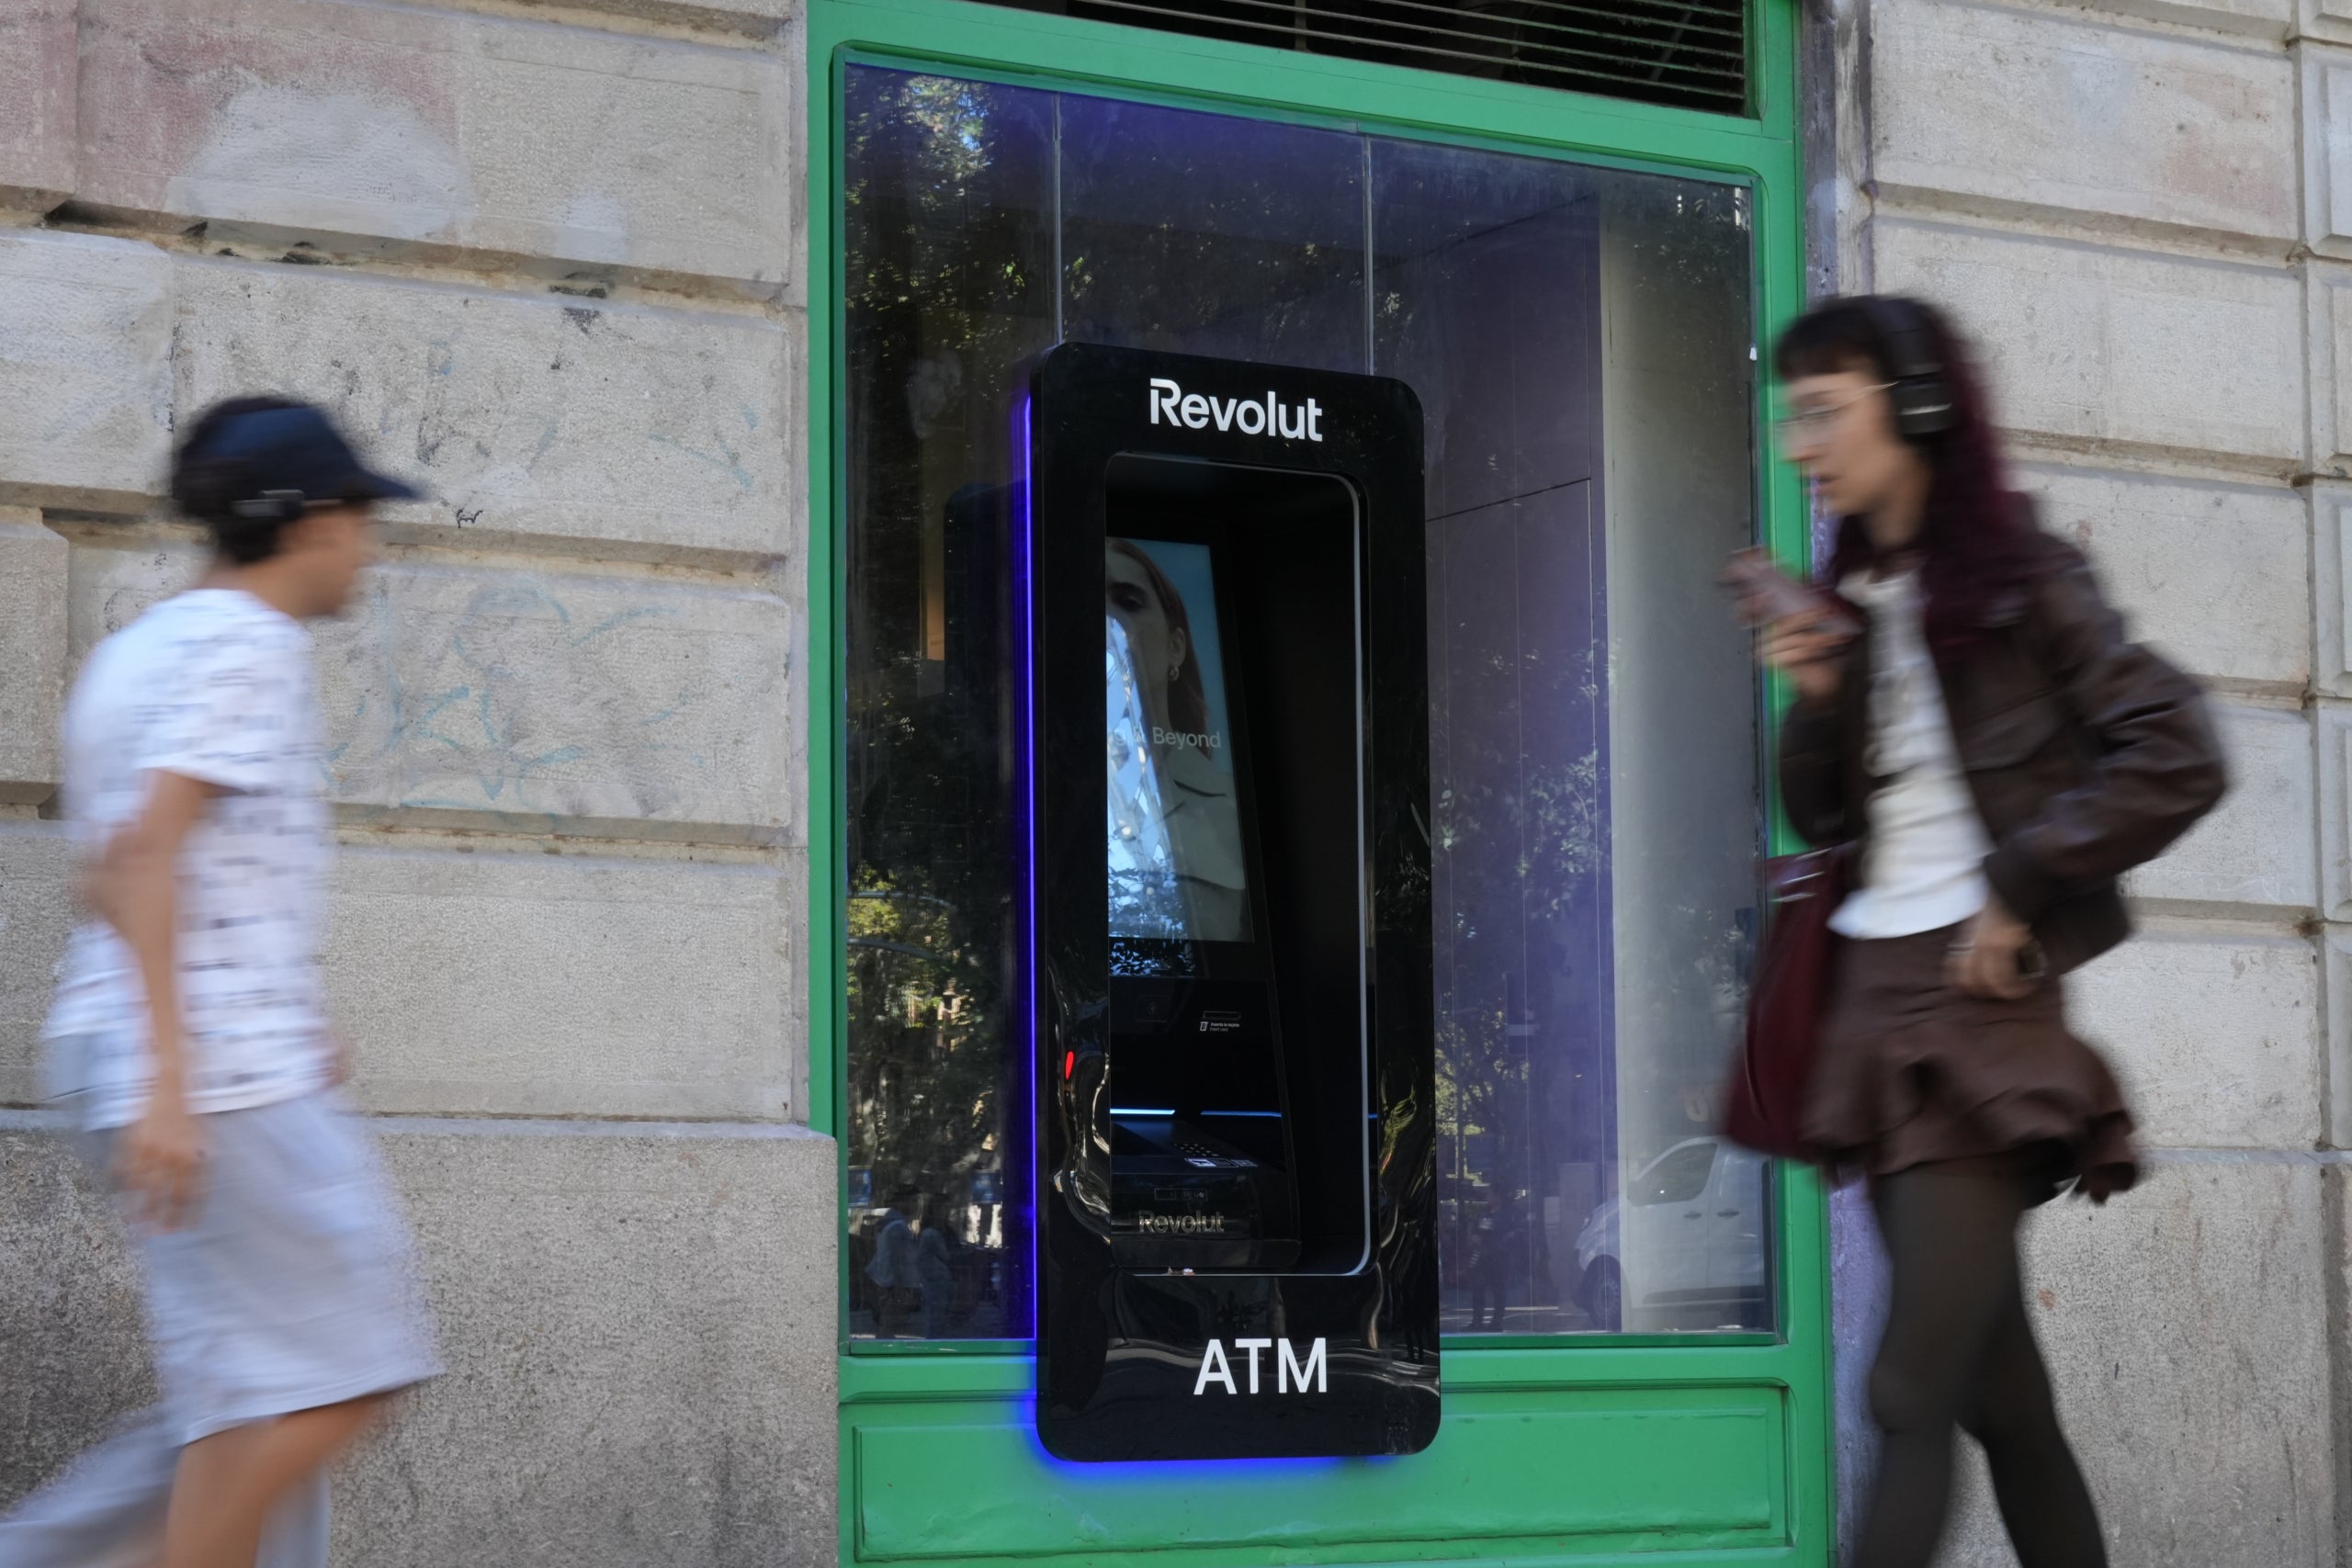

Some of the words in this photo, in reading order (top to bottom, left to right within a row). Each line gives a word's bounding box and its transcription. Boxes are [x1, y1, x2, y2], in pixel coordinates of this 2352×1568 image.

[1150, 378, 1323, 442] Revolut
[1152, 727, 1221, 750] Beyond
[1139, 1210, 1225, 1234] Revolut
[1193, 1337, 1327, 1395] ATM
